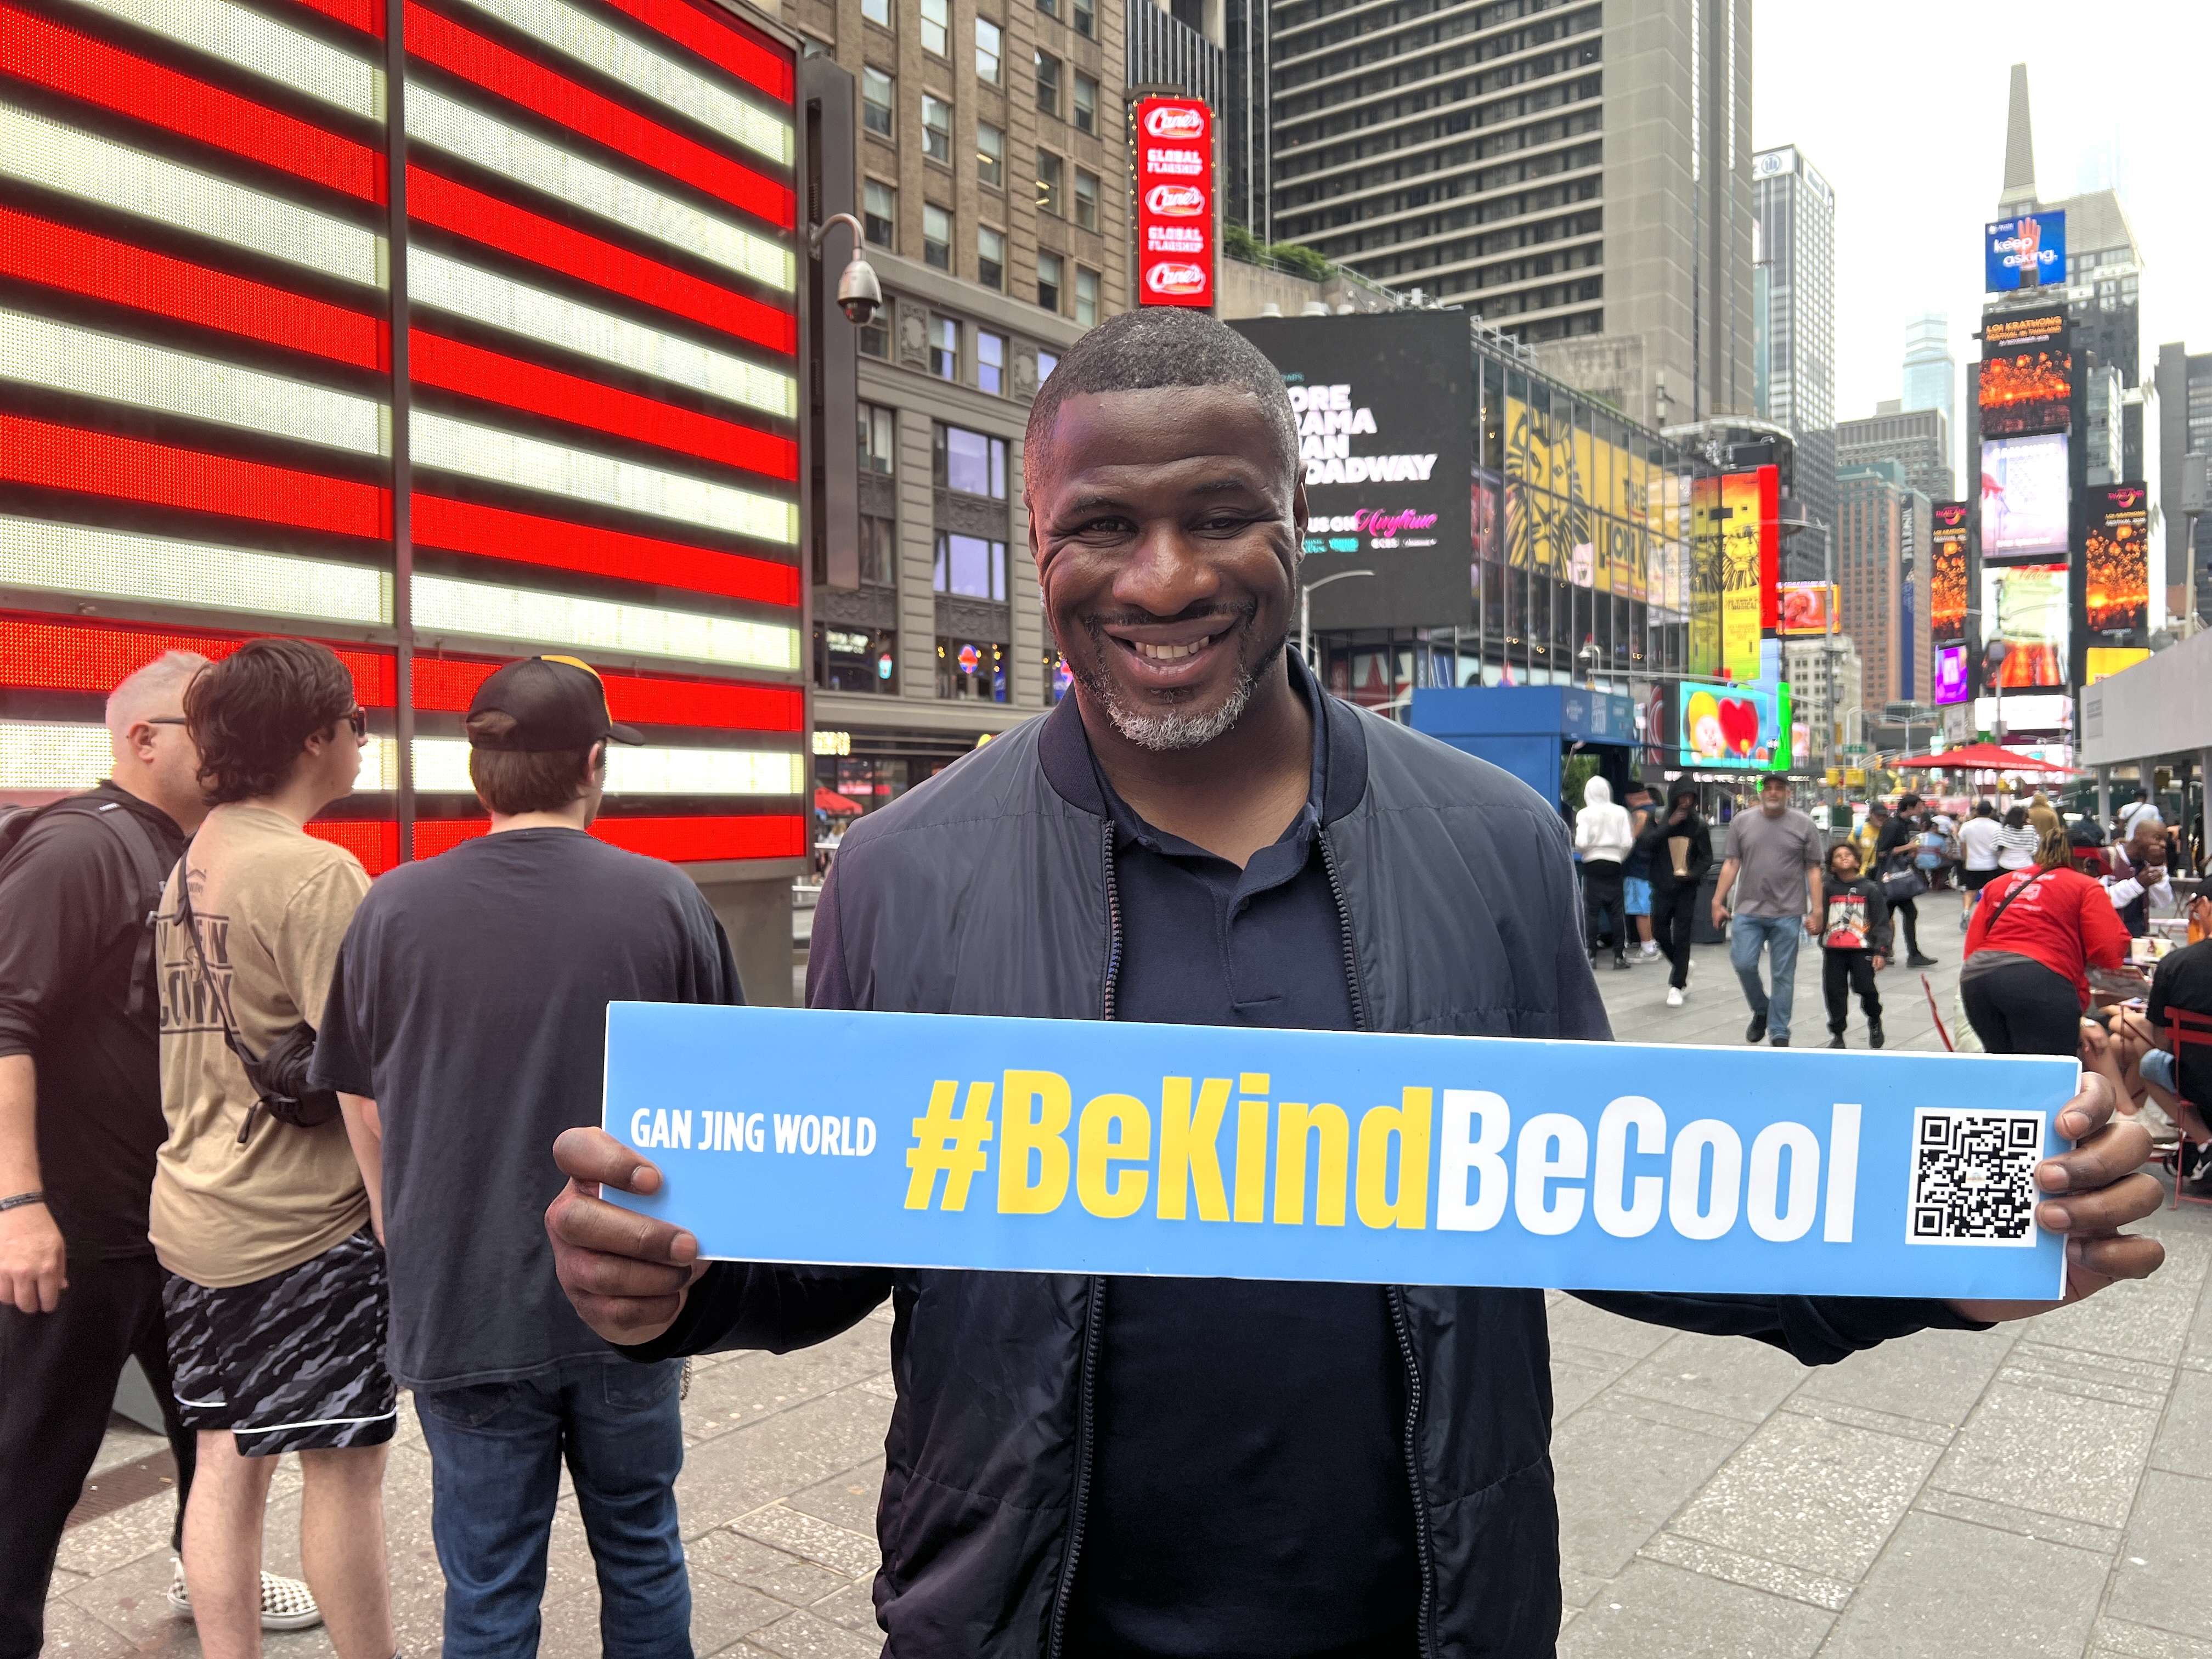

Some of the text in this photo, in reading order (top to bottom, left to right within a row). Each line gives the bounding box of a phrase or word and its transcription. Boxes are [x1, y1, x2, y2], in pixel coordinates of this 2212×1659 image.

[1148, 109, 1200, 133] Cane's
[1147, 148, 1203, 164] GLOBAL
[1147, 162, 1203, 176] FLAGSHIP
[1149, 185, 1201, 211] Cane's
[1147, 239, 1204, 253] FLAGSHIP
[1148, 225, 1204, 241] GLOBAL
[1994, 237, 2033, 254] keep
[2003, 249, 2058, 268] asking.
[1150, 262, 1202, 289] Cane's
[1287, 384, 1351, 413] ORE
[1294, 408, 1378, 436] AMA
[1298, 433, 1350, 460] AN
[1305, 453, 1438, 486] OADWAY
[631, 1108, 877, 1156] GAN JING WORLD
[906, 1071, 1861, 1243] #BeKindBeCool
